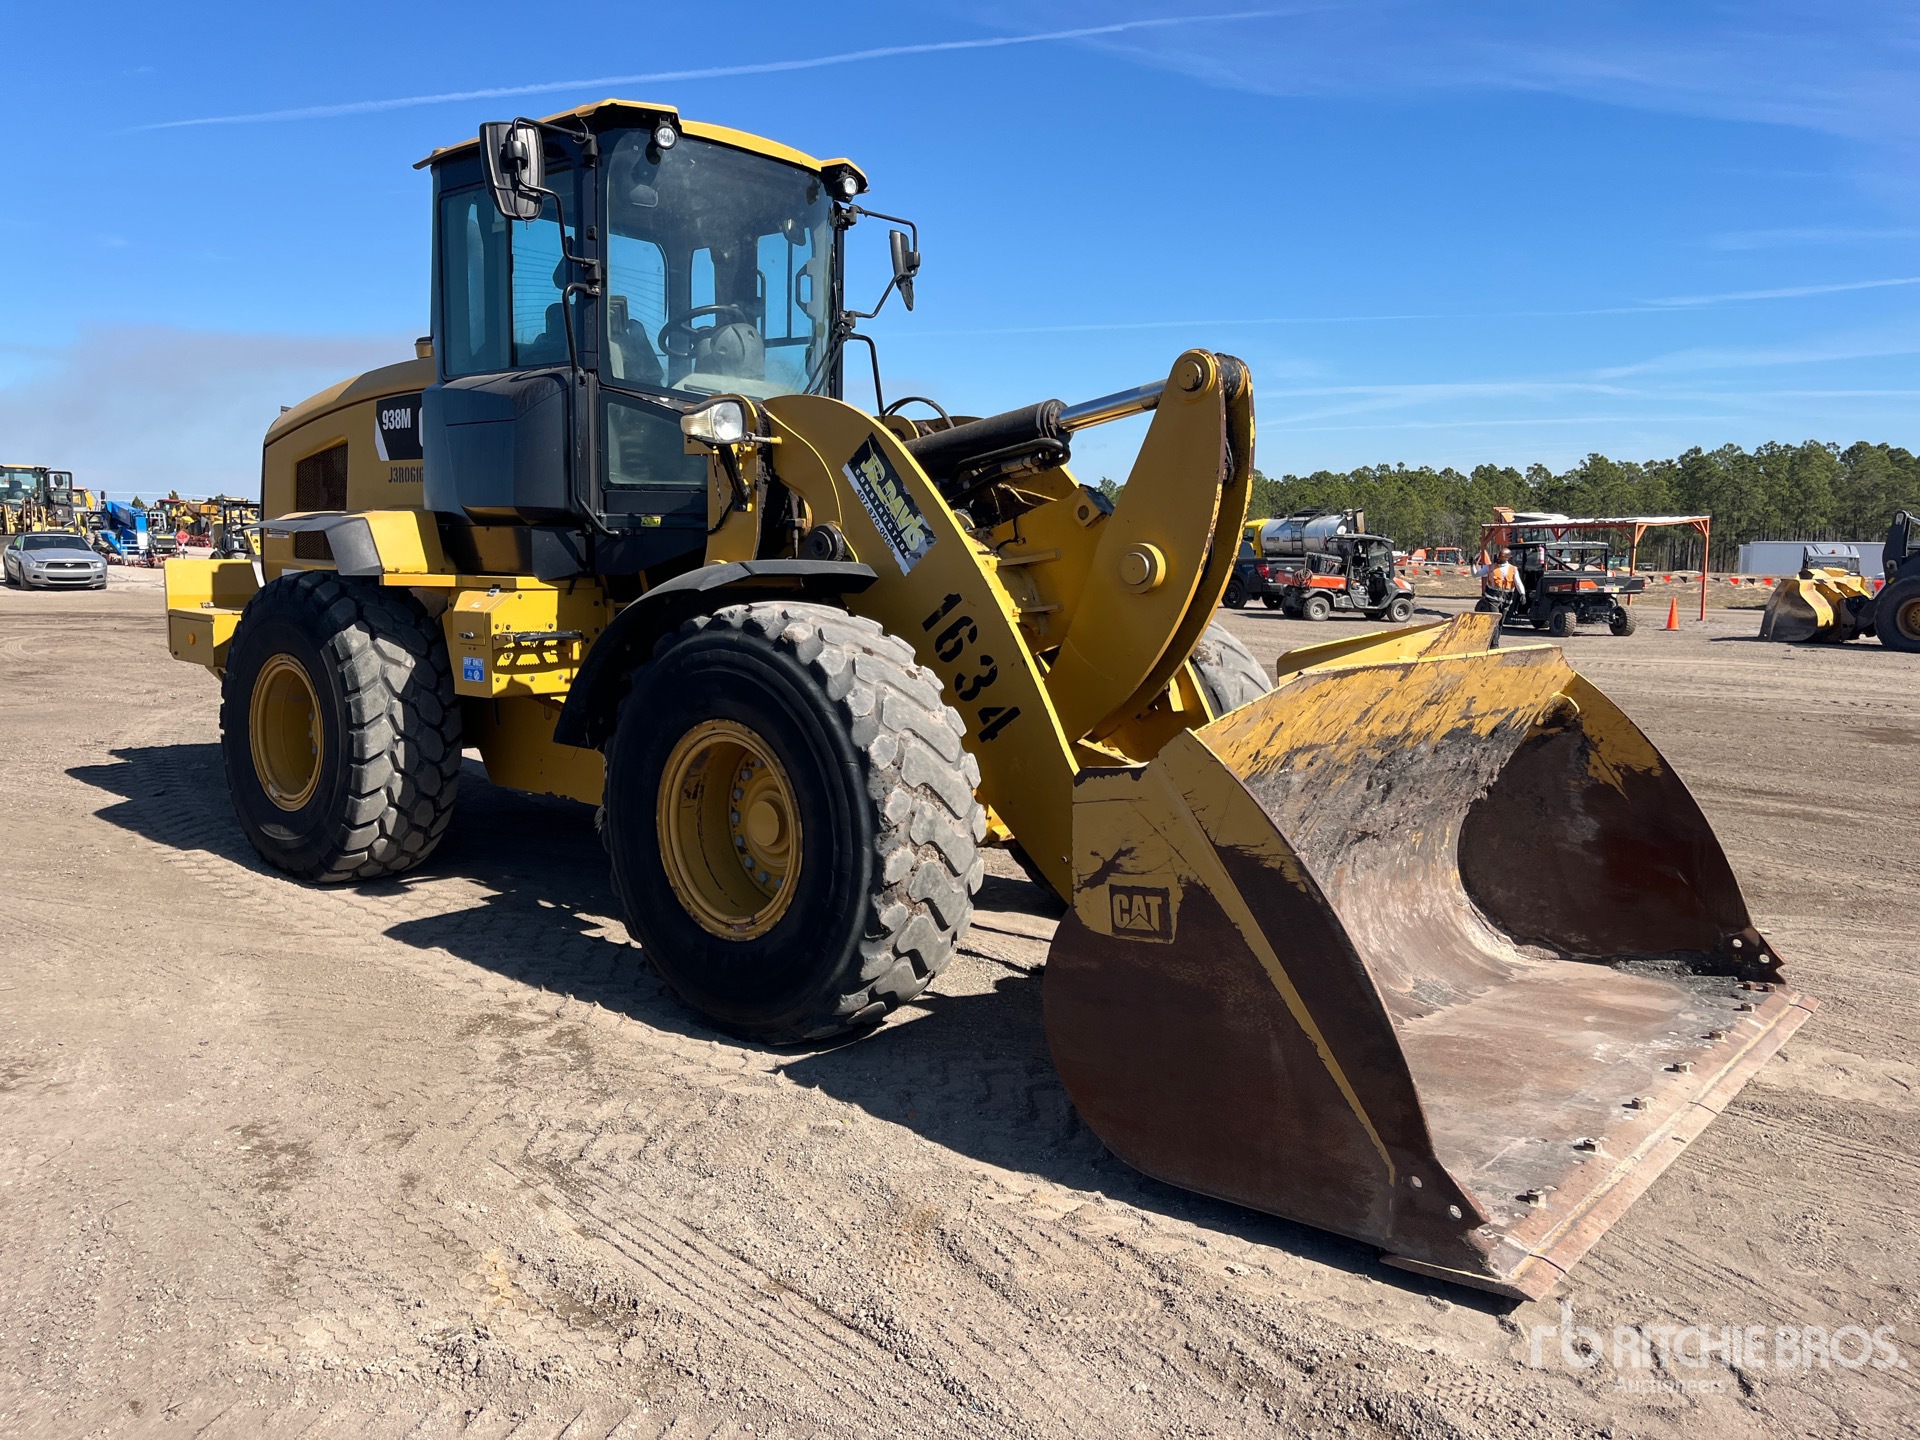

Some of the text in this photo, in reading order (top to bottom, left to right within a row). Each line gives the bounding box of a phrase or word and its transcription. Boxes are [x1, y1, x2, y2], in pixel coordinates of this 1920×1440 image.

[382, 408, 411, 430] 938M
[855, 468, 911, 559] CONSTRUCTION
[922, 593, 1021, 743] 1634
[1112, 893, 1162, 932] CAT
